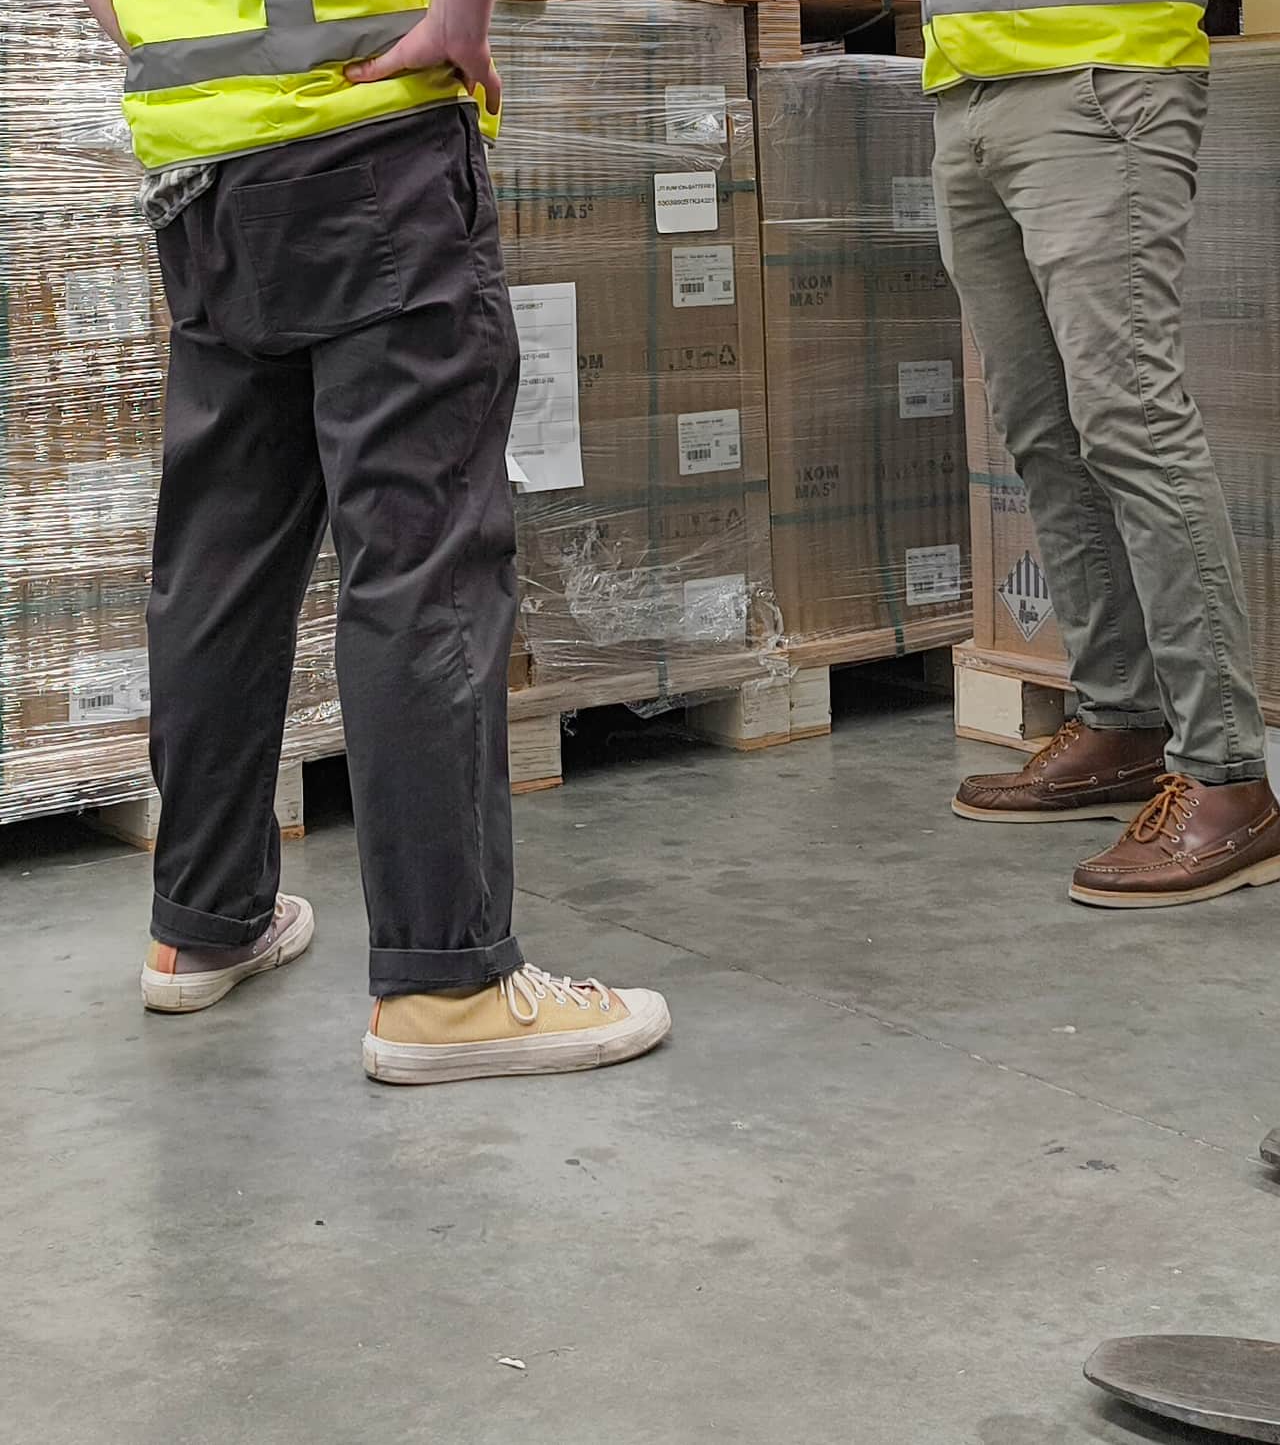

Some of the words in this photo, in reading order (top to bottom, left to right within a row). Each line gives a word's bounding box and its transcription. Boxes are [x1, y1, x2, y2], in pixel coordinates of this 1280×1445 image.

[547, 203, 594, 220] MA5°
[789, 275, 833, 291] 1KOM
[789, 290, 829, 307] MA5°
[797, 464, 840, 483] 1KOM
[795, 481, 837, 499] MA5°
